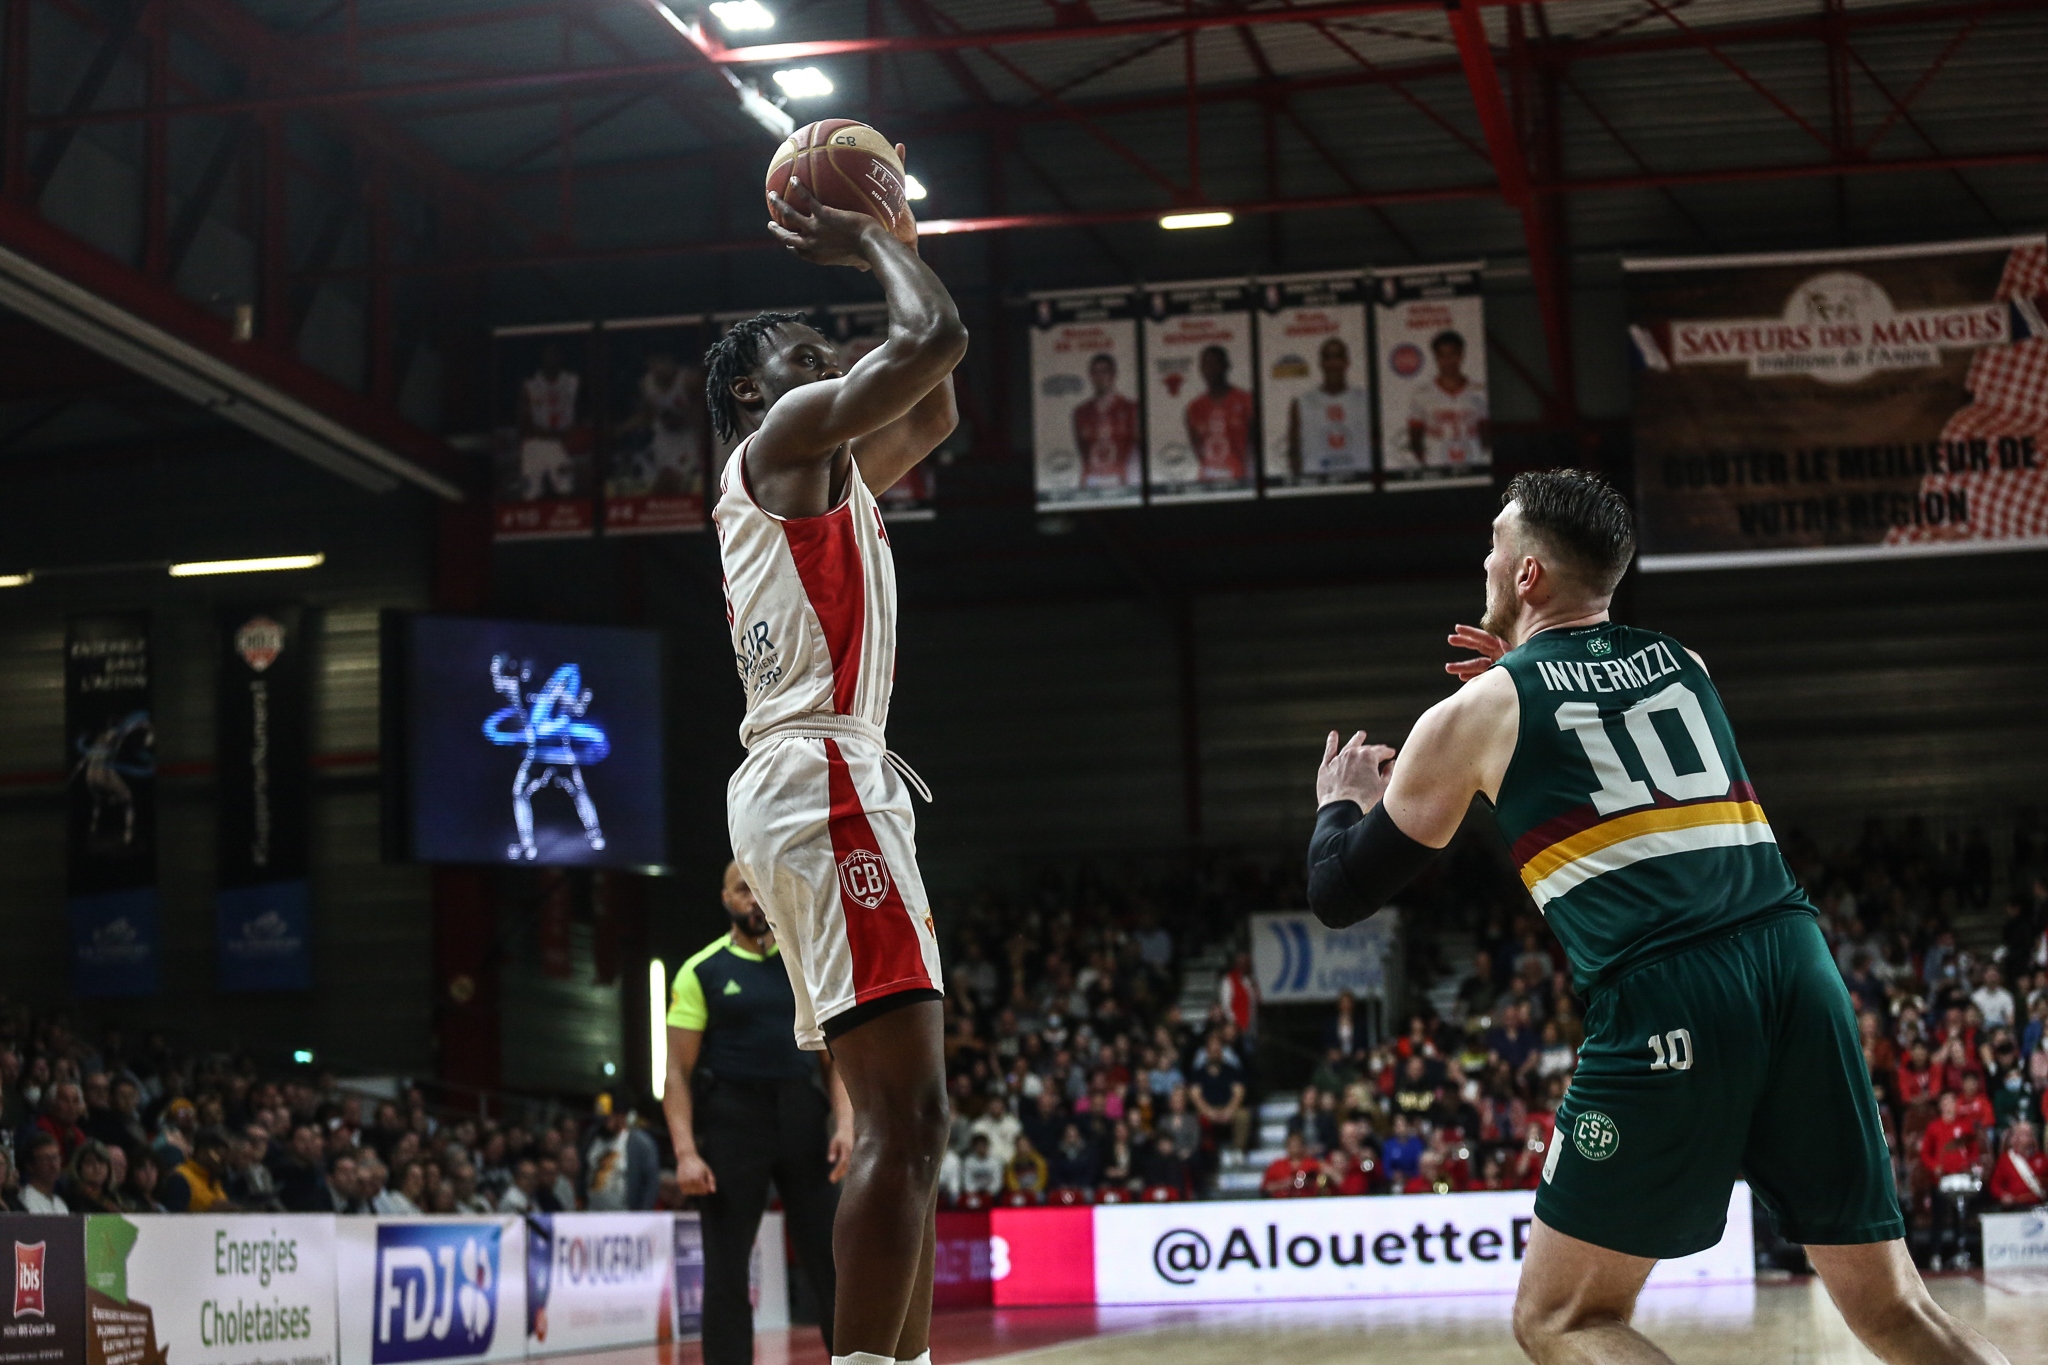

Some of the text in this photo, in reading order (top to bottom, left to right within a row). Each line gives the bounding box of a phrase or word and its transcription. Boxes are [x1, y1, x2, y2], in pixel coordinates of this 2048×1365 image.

[835, 136, 857, 147] CB
[1680, 308, 2001, 357] SAVEURS DES MAUGES
[1838, 438, 1989, 477] MEILLEUR
[1999, 435, 2037, 470] DE
[1554, 682, 1731, 817] 10
[849, 862, 884, 898] CB
[1648, 1028, 1694, 1071] 10
[1578, 1120, 1613, 1148] CSP
[19, 1263, 40, 1292] ibis
[215, 1229, 298, 1288] Energies
[379, 1245, 456, 1344] FDJ
[201, 1295, 311, 1348] Choletaises
